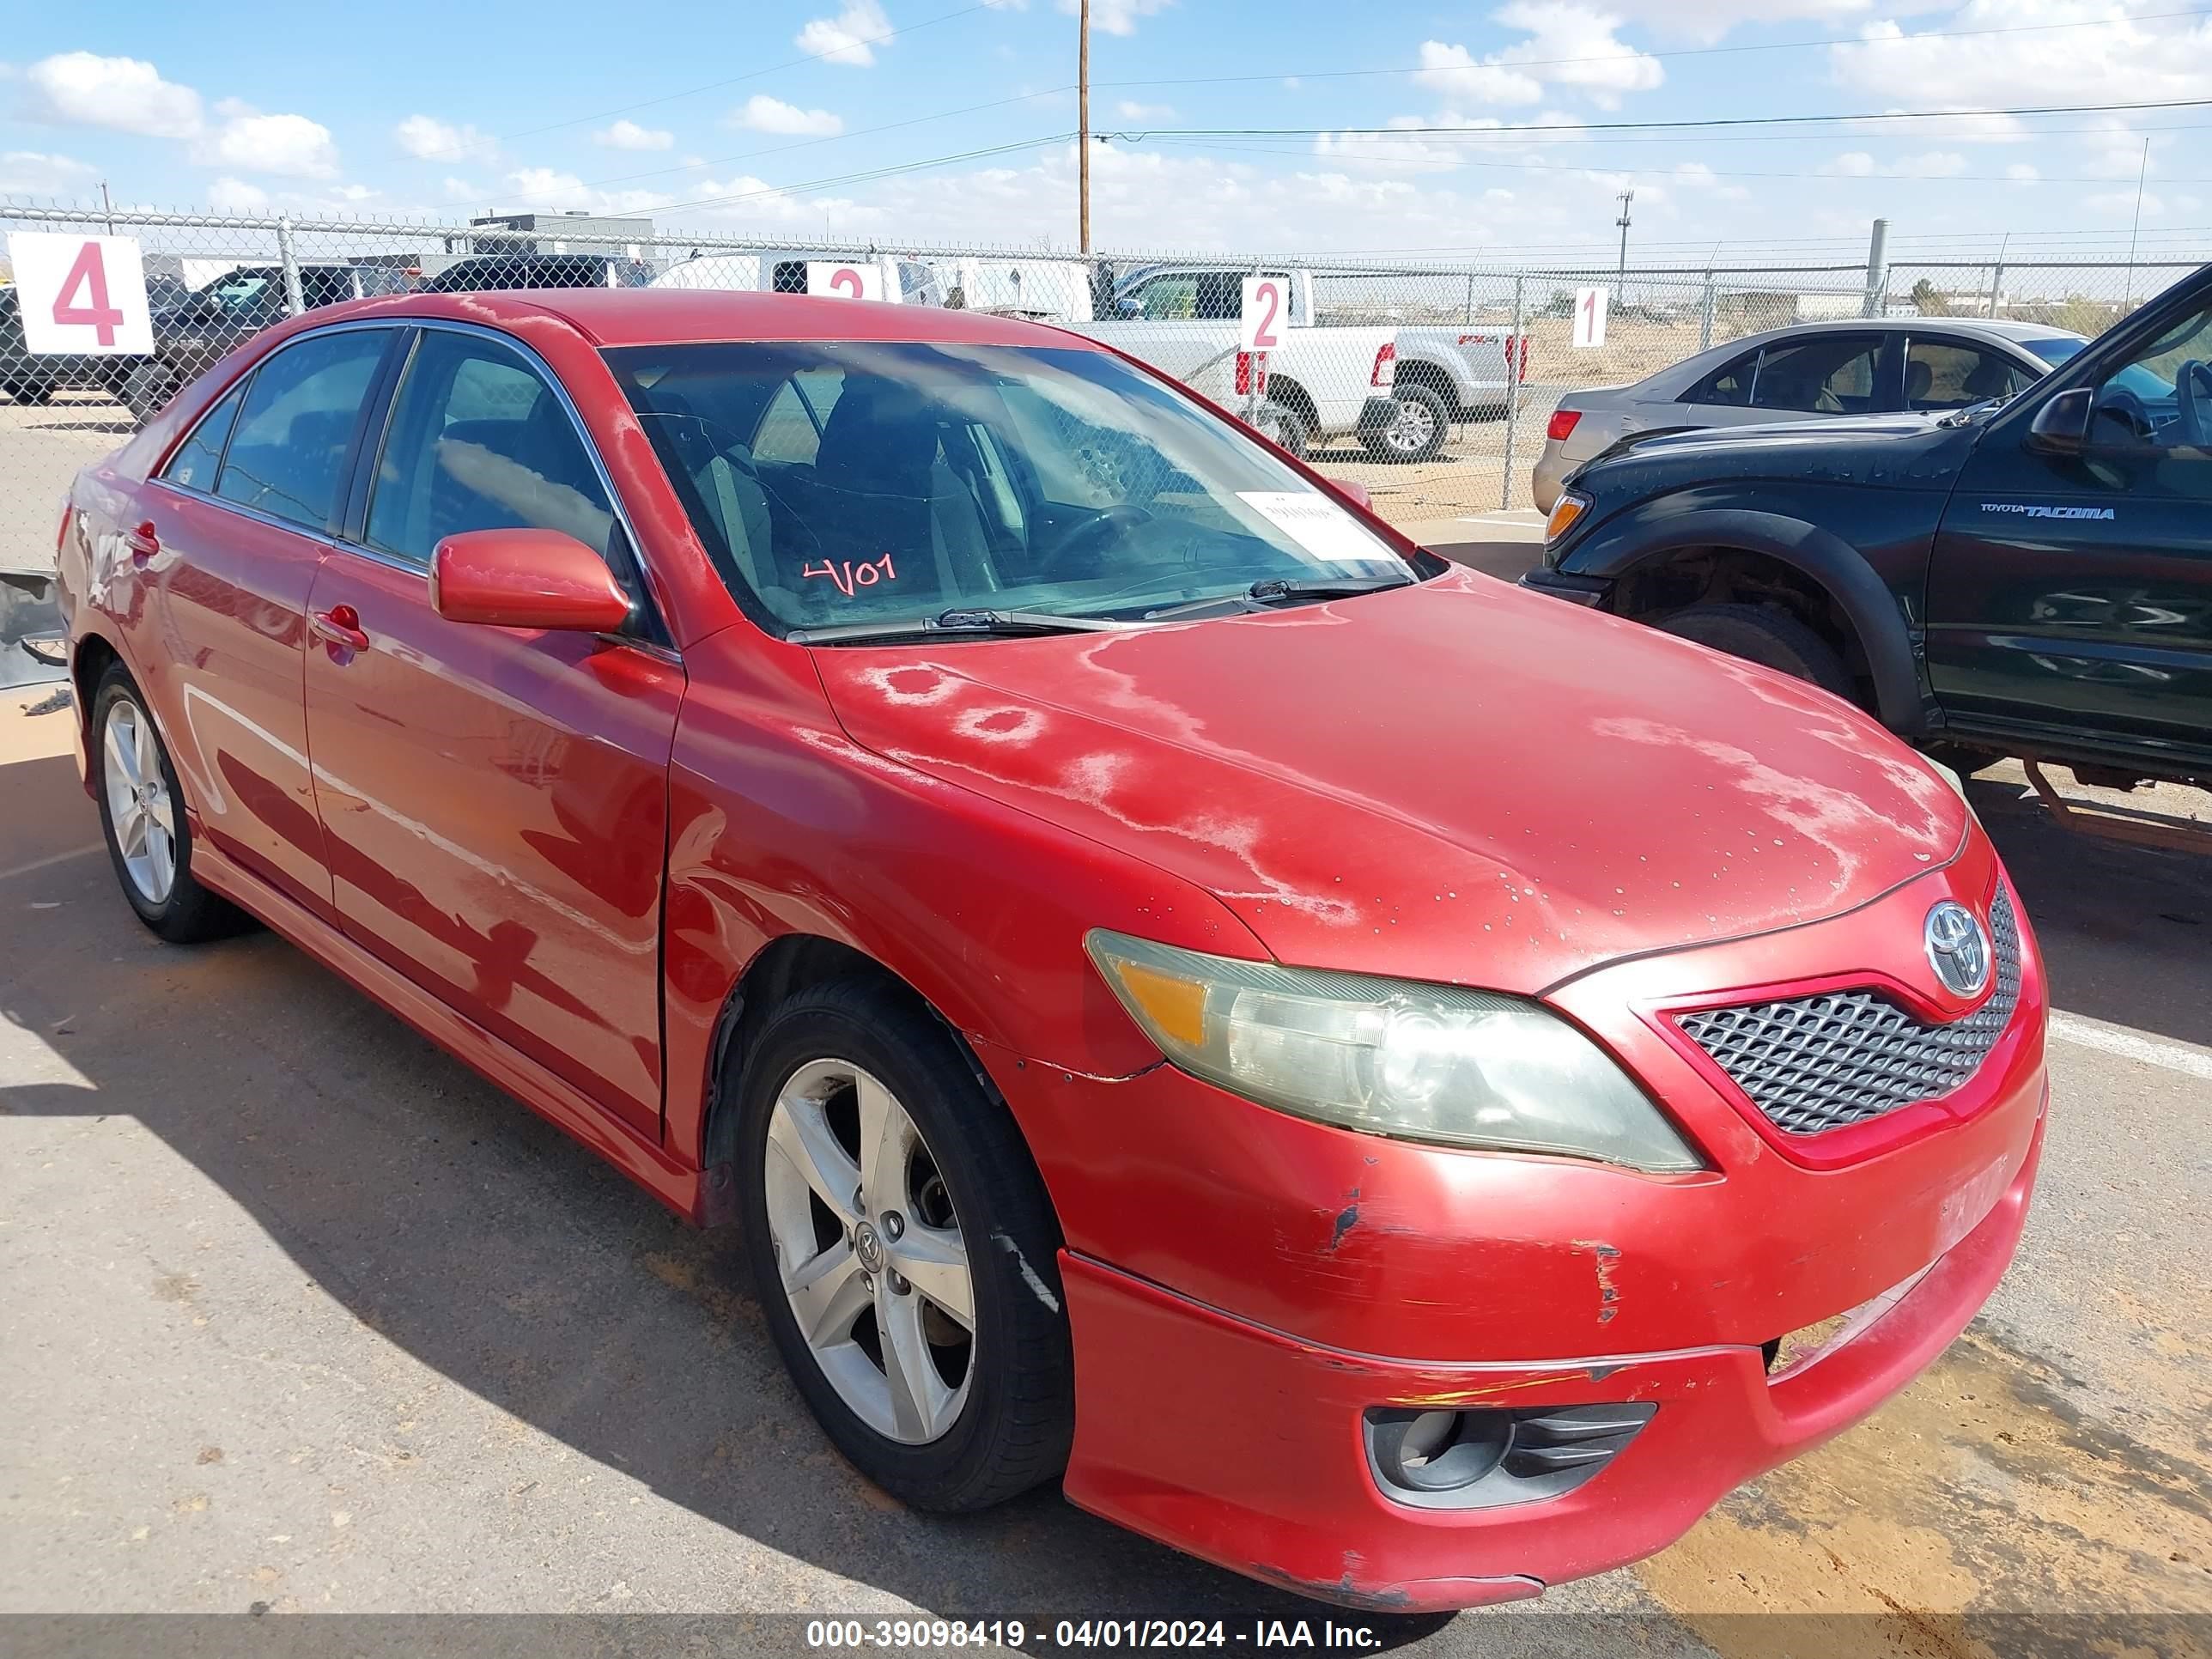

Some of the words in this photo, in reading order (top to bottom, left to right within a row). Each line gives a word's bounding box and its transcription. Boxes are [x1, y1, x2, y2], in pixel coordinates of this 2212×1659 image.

[52, 242, 124, 346] 4
[1254, 283, 1278, 346] 2
[1583, 290, 1595, 343] 1
[1980, 503, 2025, 513] TOYOTA
[2024, 507, 2115, 520] TACOMA
